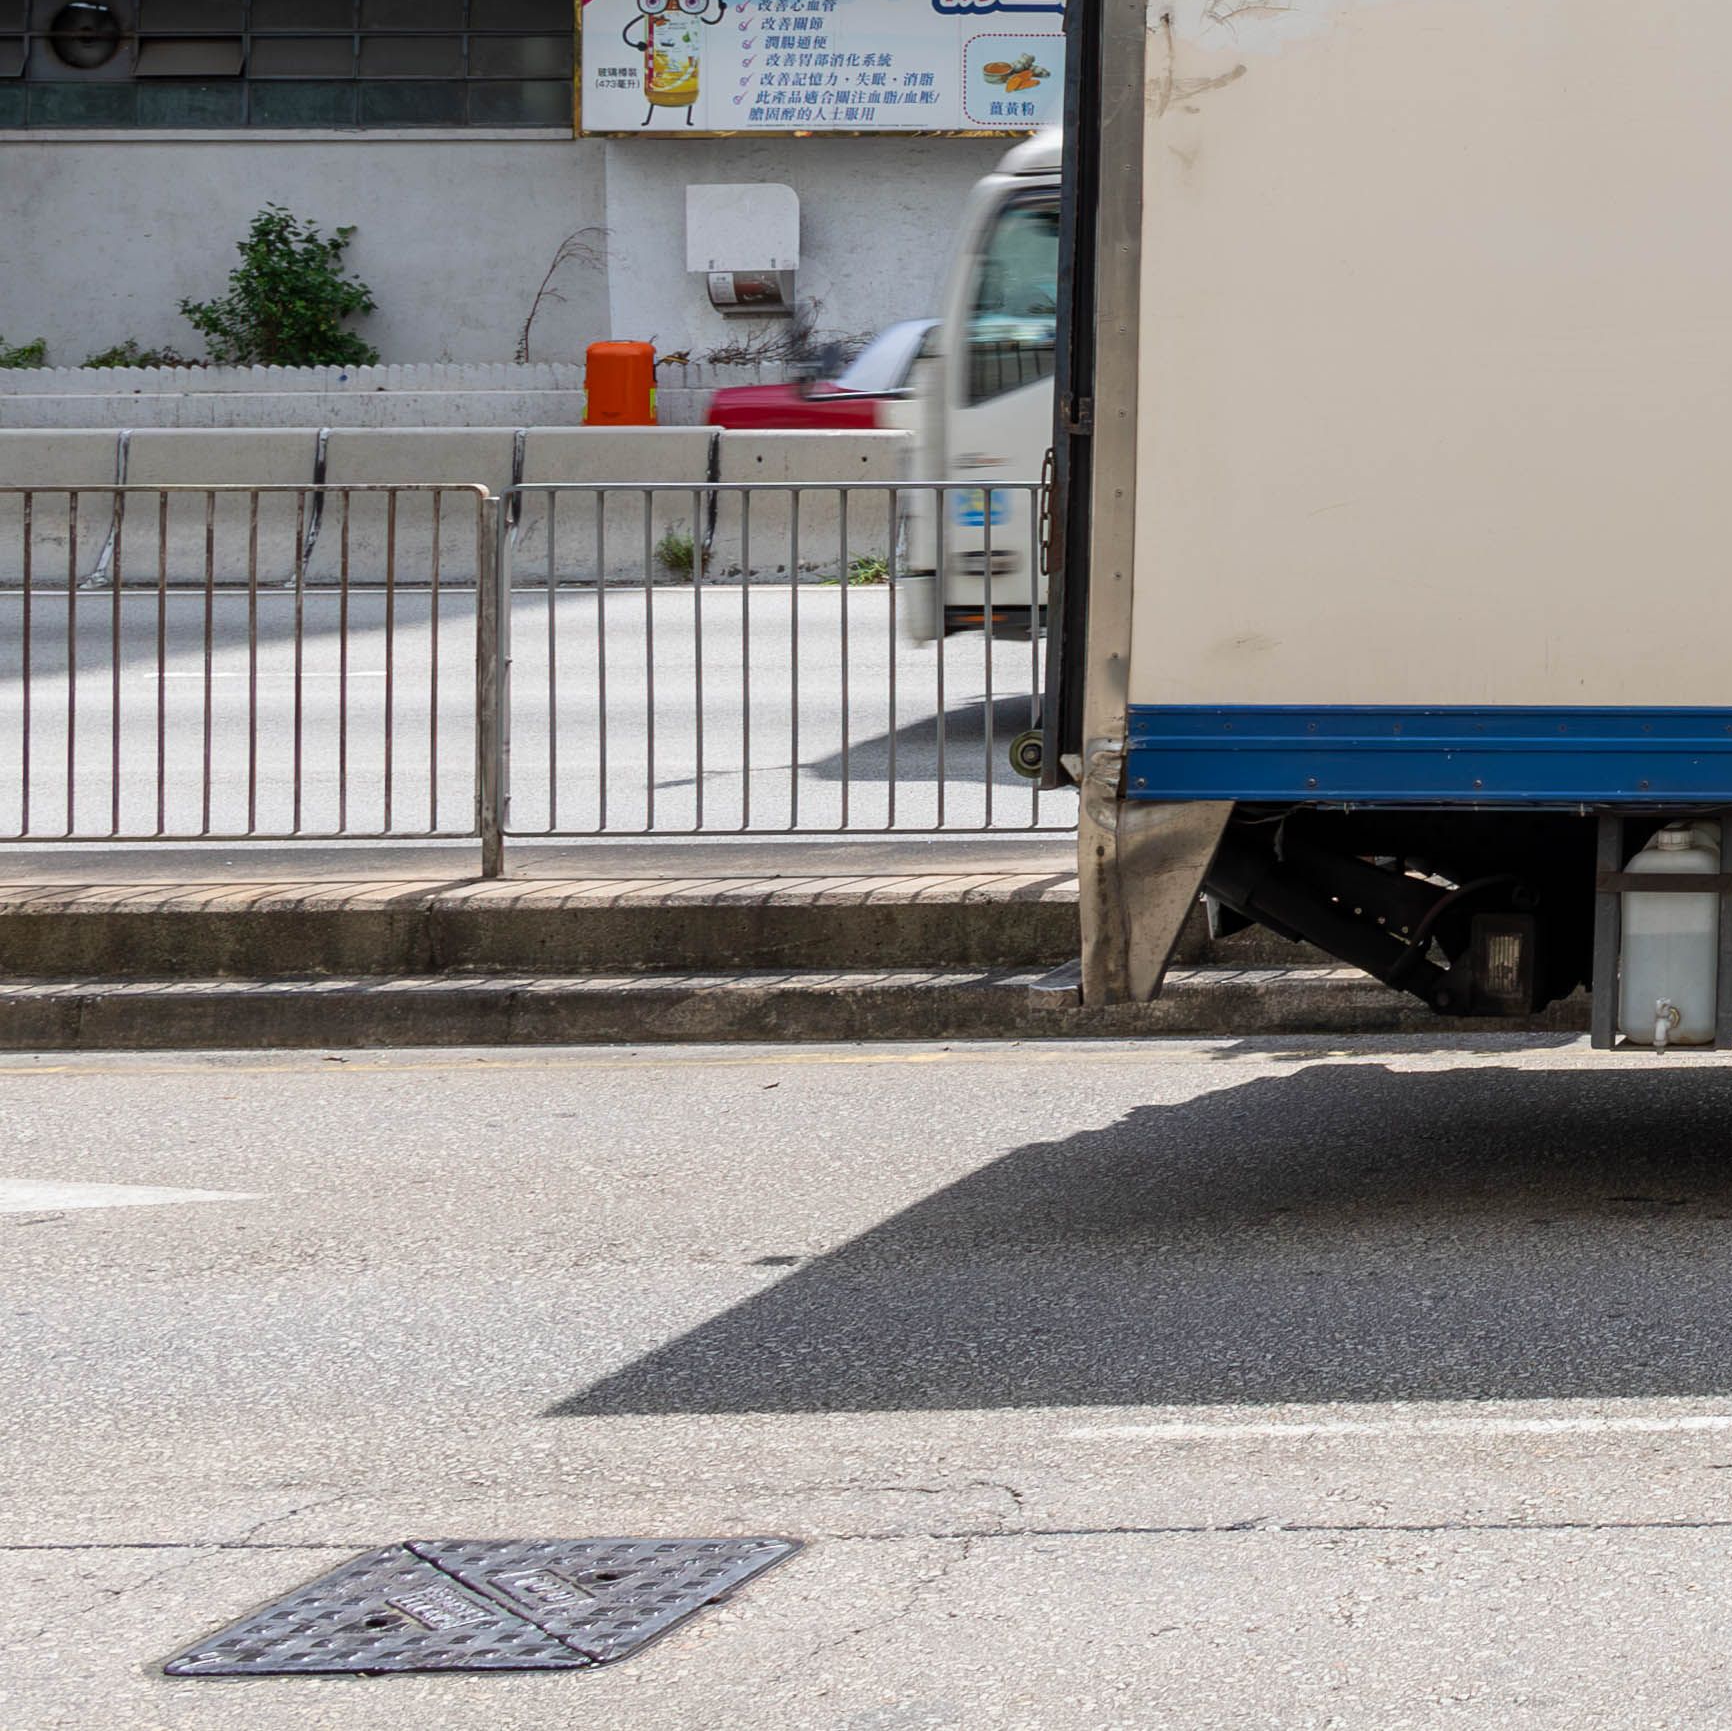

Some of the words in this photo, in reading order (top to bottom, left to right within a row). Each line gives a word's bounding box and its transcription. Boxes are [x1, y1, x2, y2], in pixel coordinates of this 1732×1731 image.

[760, 16, 824, 31] 改善關節
[990, 101, 1035, 117] 薑黃粉
